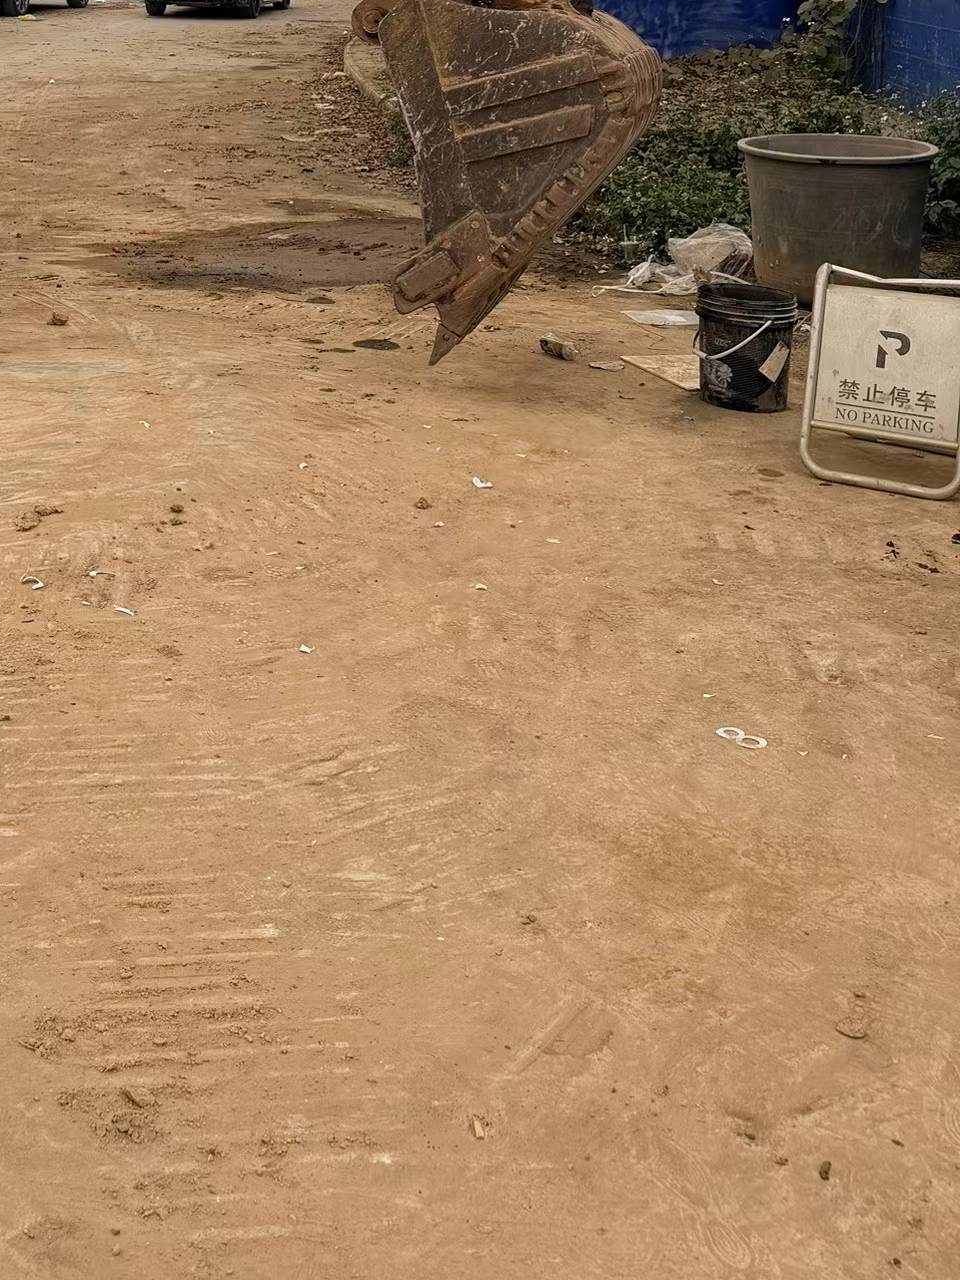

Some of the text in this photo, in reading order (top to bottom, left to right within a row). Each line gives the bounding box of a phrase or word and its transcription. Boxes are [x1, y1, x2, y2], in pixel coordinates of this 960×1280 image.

[838, 379, 937, 412] 禁止停车
[835, 407, 934, 433] NO PARKING
